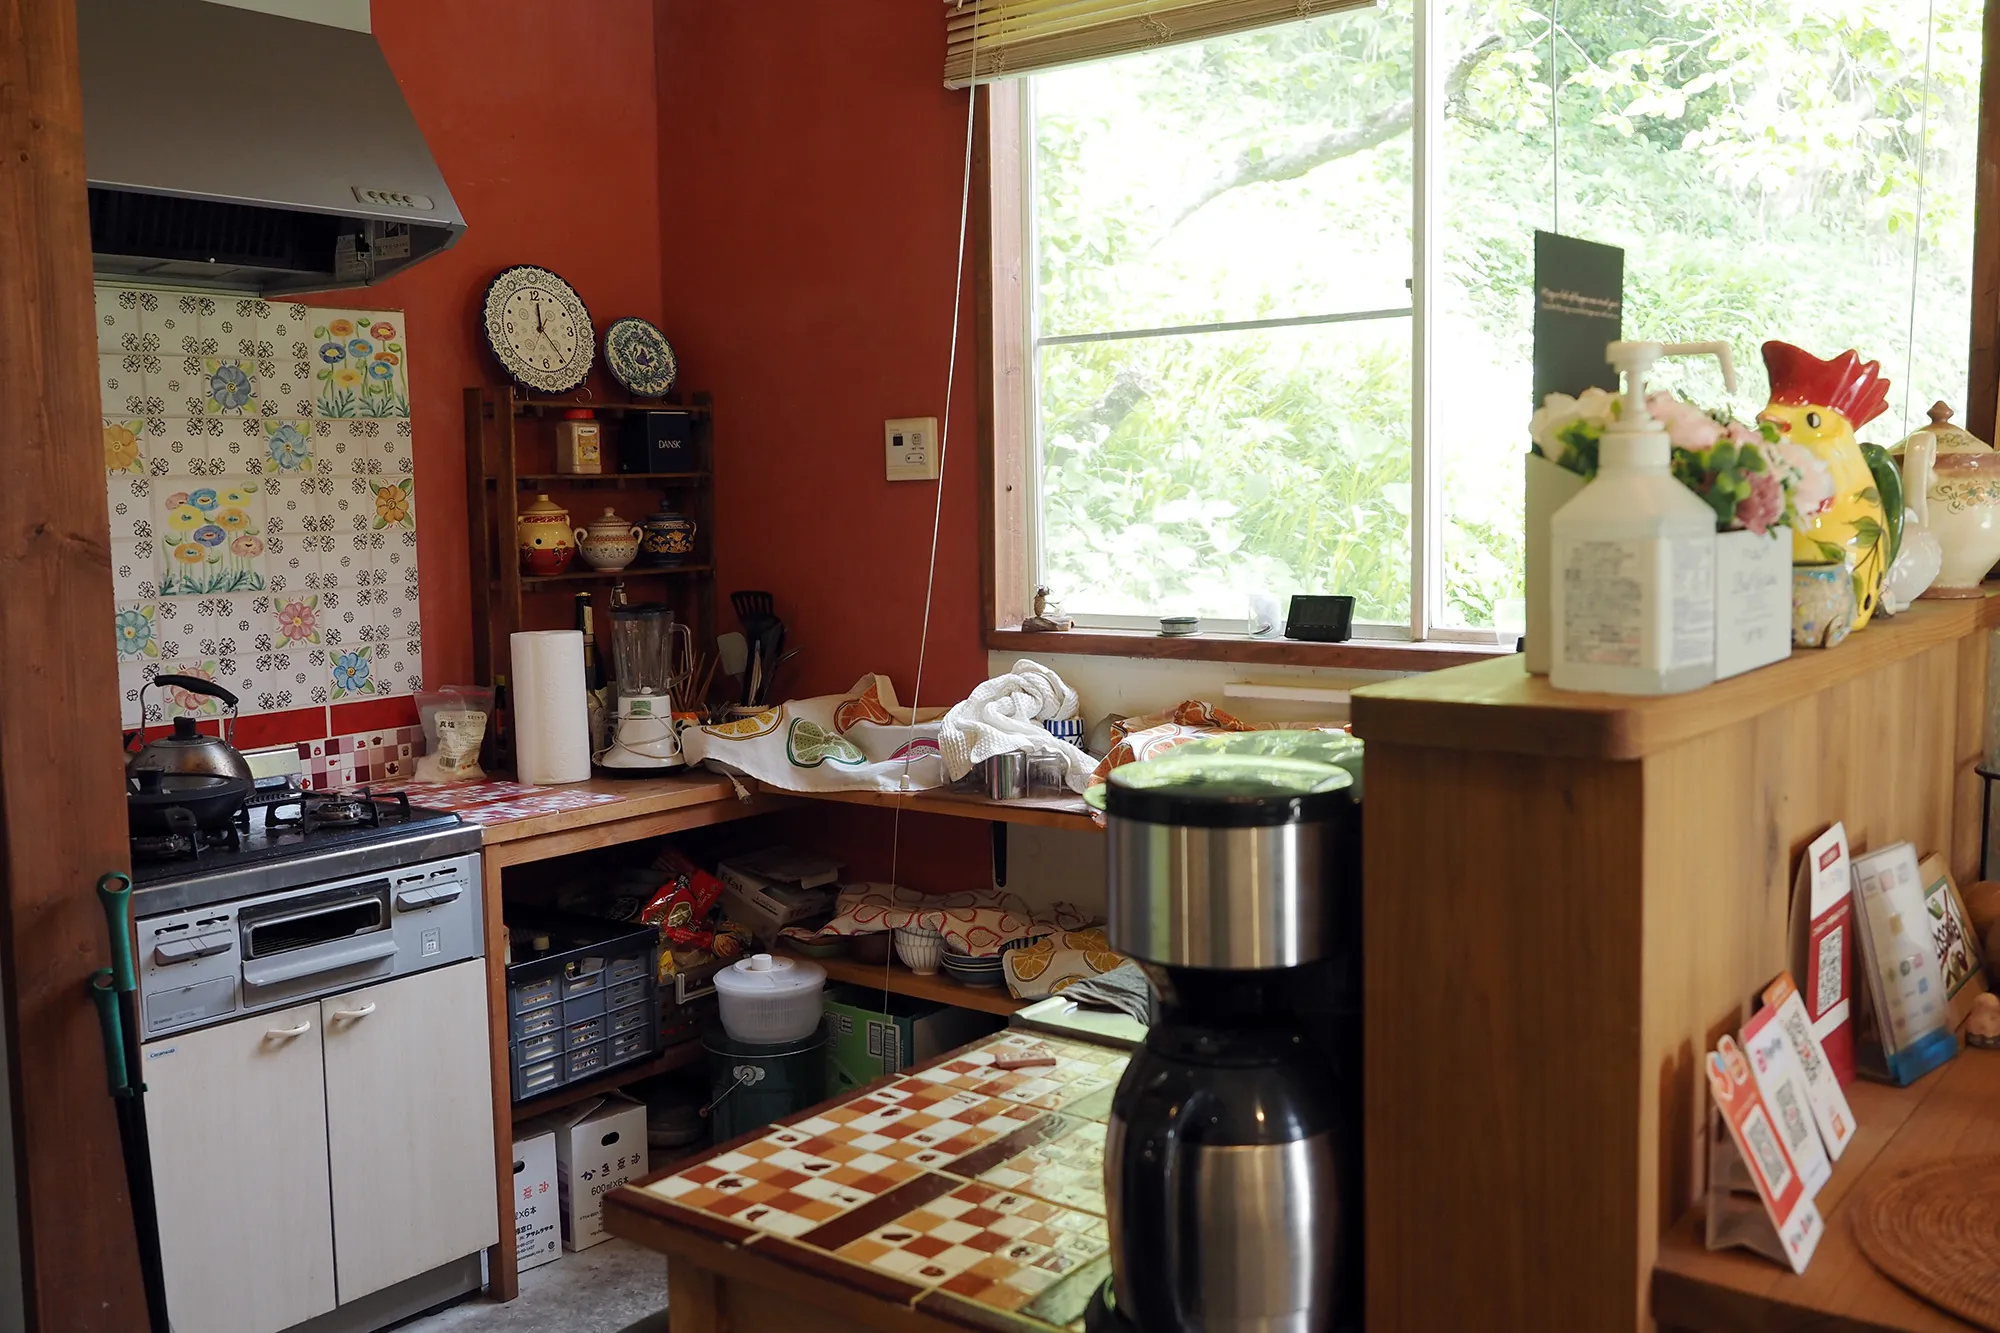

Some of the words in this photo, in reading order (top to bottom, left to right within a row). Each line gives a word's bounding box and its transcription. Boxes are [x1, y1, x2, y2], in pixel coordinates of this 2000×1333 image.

[529, 290, 539, 301] 12
[506, 322, 514, 334] 9
[566, 326, 574, 337] 3
[542, 358, 550, 369] 6
[658, 440, 681, 449] DANSK
